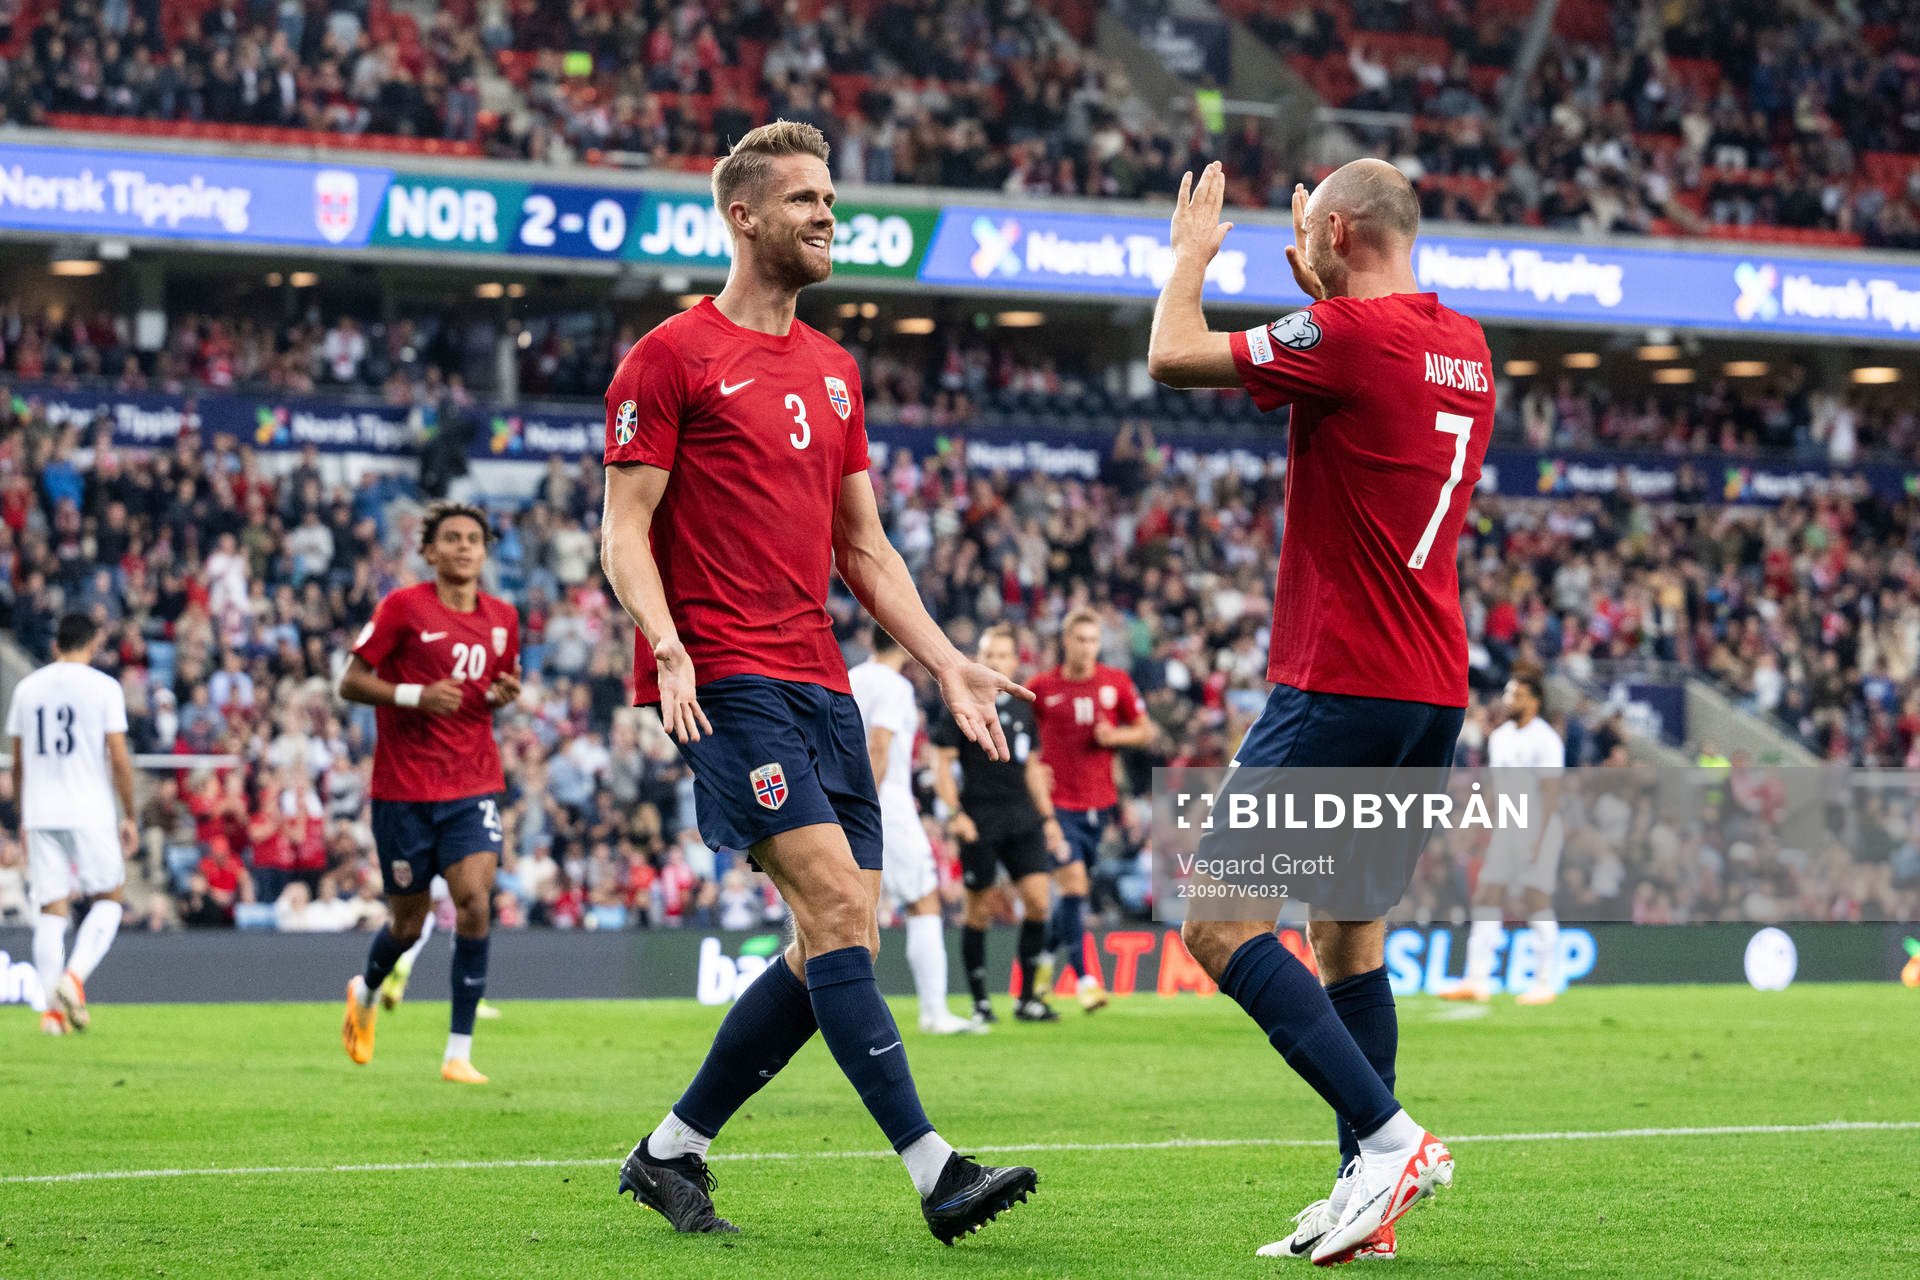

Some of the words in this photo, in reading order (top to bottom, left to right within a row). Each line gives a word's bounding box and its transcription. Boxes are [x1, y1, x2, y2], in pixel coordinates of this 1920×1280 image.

[0, 166, 105, 213] Norsk
[108, 169, 251, 233] Tipping
[387, 184, 498, 243] NOR
[519, 194, 627, 251] 2-0
[832, 213, 914, 268] :20
[1424, 351, 1488, 392] AURSNES
[784, 393, 811, 450] 3
[1407, 410, 1474, 570] 7
[452, 642, 487, 680] 20
[36, 704, 76, 755] 13
